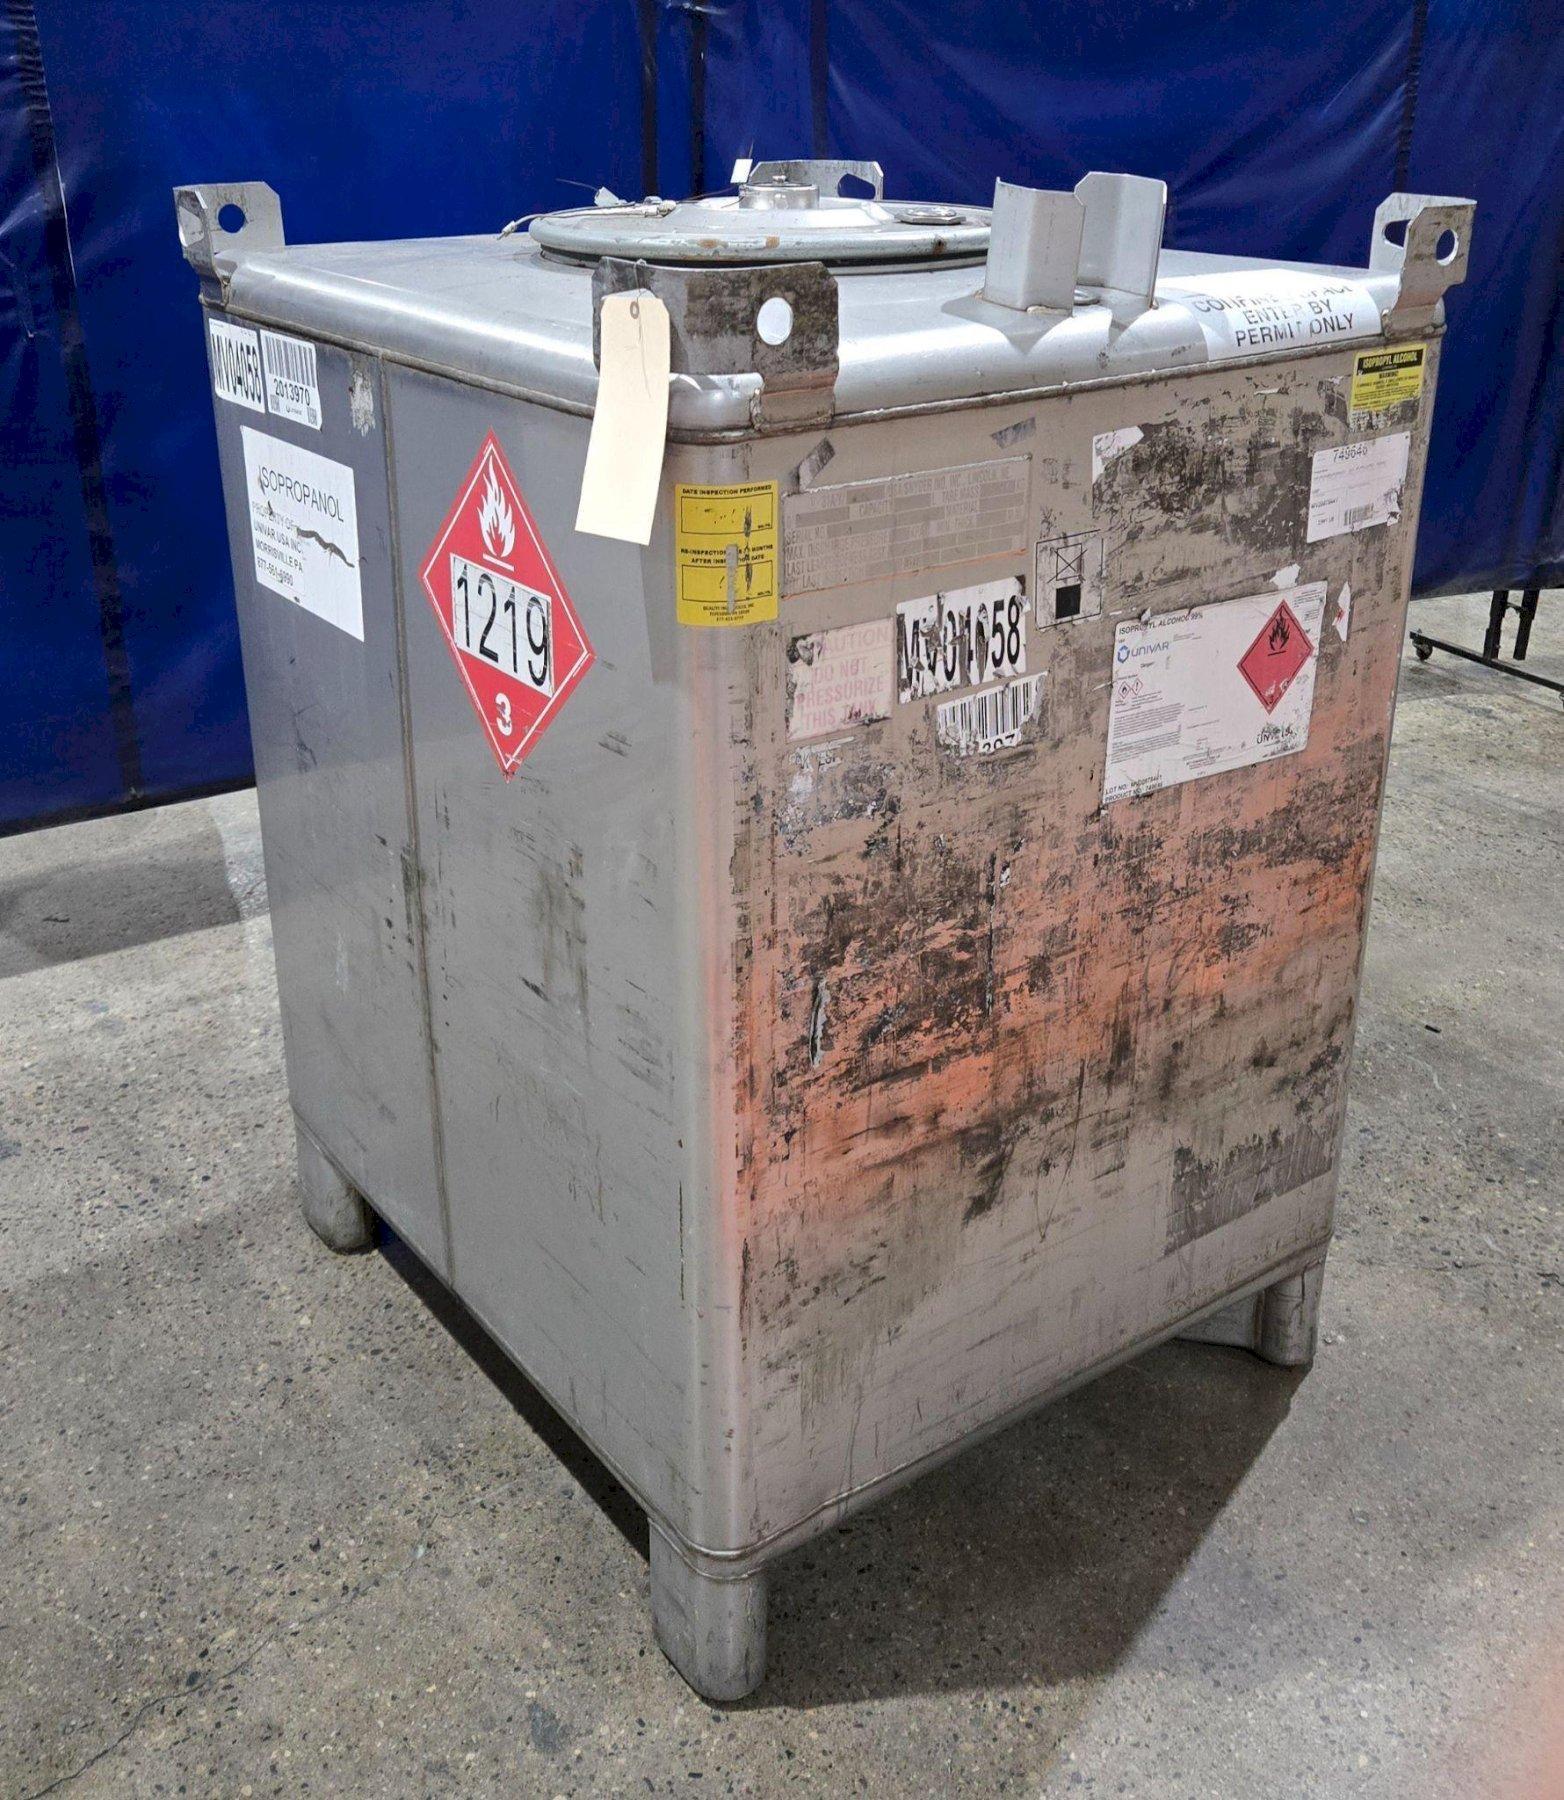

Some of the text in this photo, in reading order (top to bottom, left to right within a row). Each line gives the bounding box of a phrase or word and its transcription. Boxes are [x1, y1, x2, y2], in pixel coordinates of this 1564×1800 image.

[1309, 299, 1334, 316] BY
[1310, 312, 1355, 337] ONLY
[273, 378, 311, 407] 2013970
[258, 465, 345, 523] ISOPROPANOL
[699, 488, 739, 496] INSPECTION
[739, 484, 772, 494] PERFORMED
[457, 562, 549, 687] 1219
[812, 656, 868, 685] DO NOT
[795, 675, 884, 709] PRESSURIZE
[494, 692, 514, 737] 3
[801, 706, 837, 729] THIS
[1105, 785, 1118, 795] LOT
